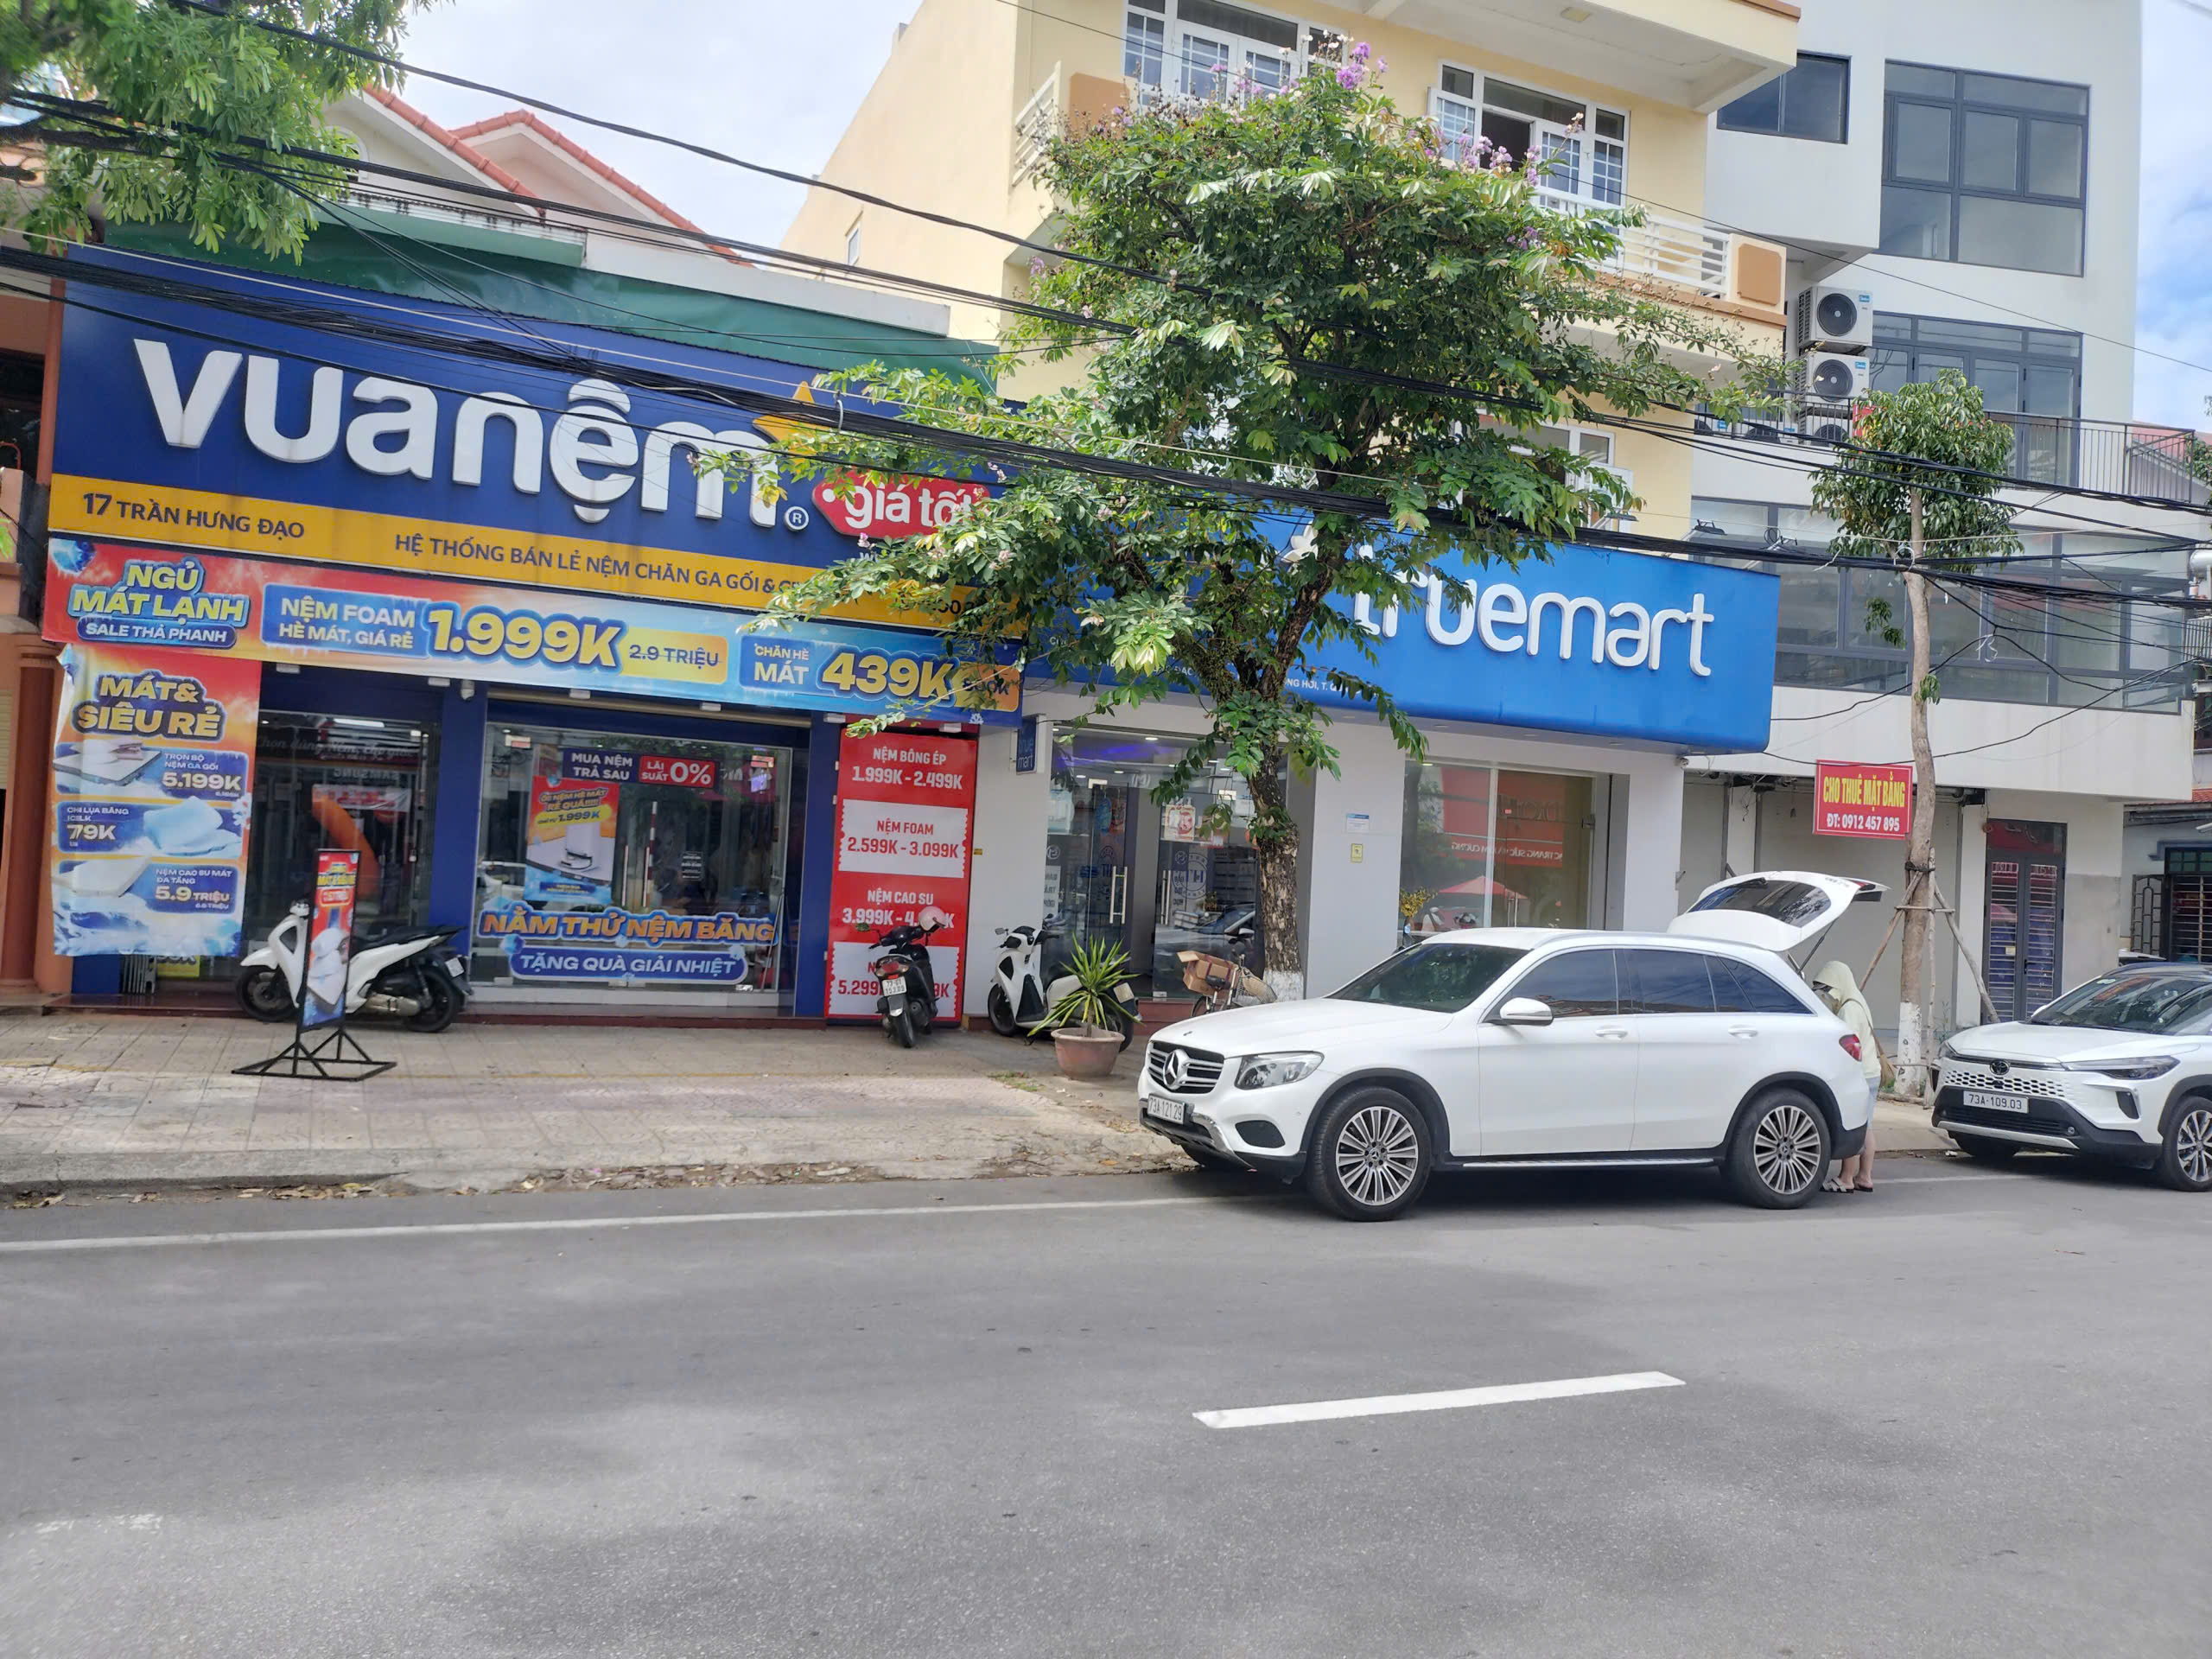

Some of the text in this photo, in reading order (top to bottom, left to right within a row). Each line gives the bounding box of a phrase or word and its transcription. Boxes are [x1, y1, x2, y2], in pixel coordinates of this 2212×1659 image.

[83, 493, 305, 542] 17 TRẦN HƯNG ĐẠO
[844, 483, 910, 529] giá
[395, 533, 424, 556] HỆ
[429, 536, 505, 562] THỐNG
[511, 546, 552, 567] BÁN
[557, 549, 581, 571] LẺ
[586, 555, 630, 577] NỆM
[635, 563, 690, 583] CHĂN
[695, 569, 721, 588] GA
[726, 570, 759, 592] GỐI
[761, 578, 775, 594] &
[126, 562, 200, 591] NGỦ
[73, 587, 245, 626] MÁT LẠNH
[281, 595, 416, 629] NỆM FOAM
[86, 623, 227, 642] SALE THẢ PHANH
[279, 622, 415, 650] HÈ MÁT, GIÁ RẺ
[429, 608, 621, 668] 1.999K
[628, 644, 719, 670] 2.9 TRIỆU
[754, 645, 809, 660] CHĂN HÈ
[754, 659, 809, 685] MÁT
[823, 652, 956, 701] 439K
[77, 701, 220, 737] SIÊU RẺ
[571, 753, 632, 767] MUA NỆM
[647, 760, 664, 770] LÃI
[873, 746, 947, 766] NỆM BÔNG ÉP
[162, 772, 242, 791] 5.199K
[574, 766, 630, 781] TRẢ SAU
[642, 772, 669, 782] SUẤT
[670, 761, 712, 785] 0%
[852, 766, 903, 785] 1.999K
[913, 771, 963, 790] 2.499K
[1823, 776, 1840, 804] CHO
[1842, 773, 1862, 804] THUÊ
[1864, 774, 1882, 812] MẶT
[877, 818, 933, 836] NỆM FOAM
[1842, 814, 1864, 830] 0912
[1866, 816, 1882, 830] 457
[1883, 817, 1900, 832] 895
[848, 836, 898, 855] 2.599K
[909, 841, 959, 859] 3.099K
[156, 886, 230, 903] 5.9 TRIỆU
[868, 887, 934, 906] NỆM CAO SU
[484, 906, 557, 935] NẰM
[563, 912, 624, 937] THỬ
[626, 916, 691, 944] NỆM
[842, 908, 893, 925] 3.999K
[520, 952, 735, 977] TẶNG QUÀ GIẢI NHIỆT
[1969, 1094, 2022, 1110] 73A-109.03
